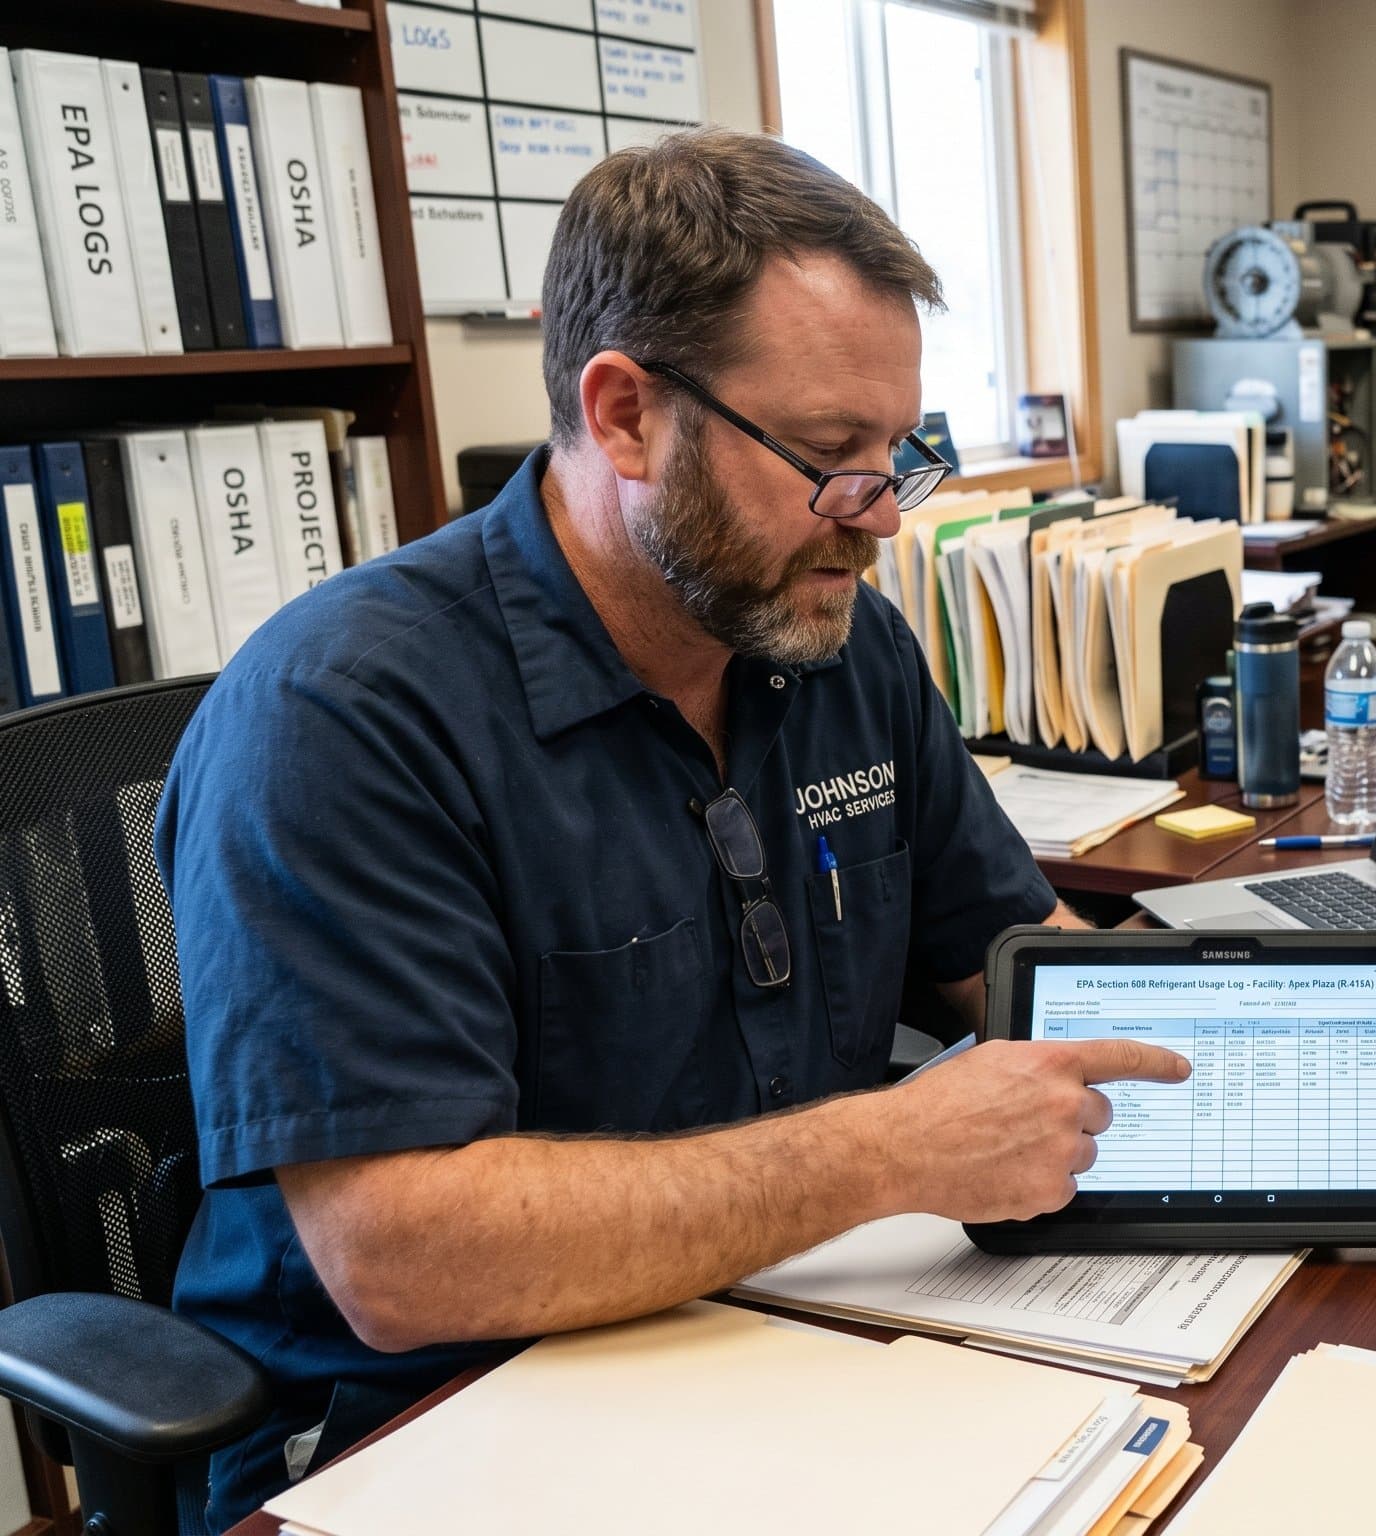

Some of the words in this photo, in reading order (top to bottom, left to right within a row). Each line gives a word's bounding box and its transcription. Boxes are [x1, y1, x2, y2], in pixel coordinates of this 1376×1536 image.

[61, 104, 95, 170] EPA
[75, 184, 113, 275] LOGS
[287, 159, 316, 248] OSHA
[223, 467, 254, 556] OSHA
[795, 760, 895, 815] JOHNSON
[808, 807, 842, 830] HVAC
[845, 790, 896, 817] SERVICES
[1076, 979, 1095, 989] EPA
[1096, 979, 1129, 989] Section
[1131, 979, 1147, 989] 608
[1148, 979, 1198, 991] Refrigerant
[1198, 979, 1226, 991] Usage
[1227, 979, 1244, 991] Log
[1252, 979, 1287, 991] Facility:
[1288, 979, 1311, 991] Apex
[1312, 979, 1336, 989] Plaza
